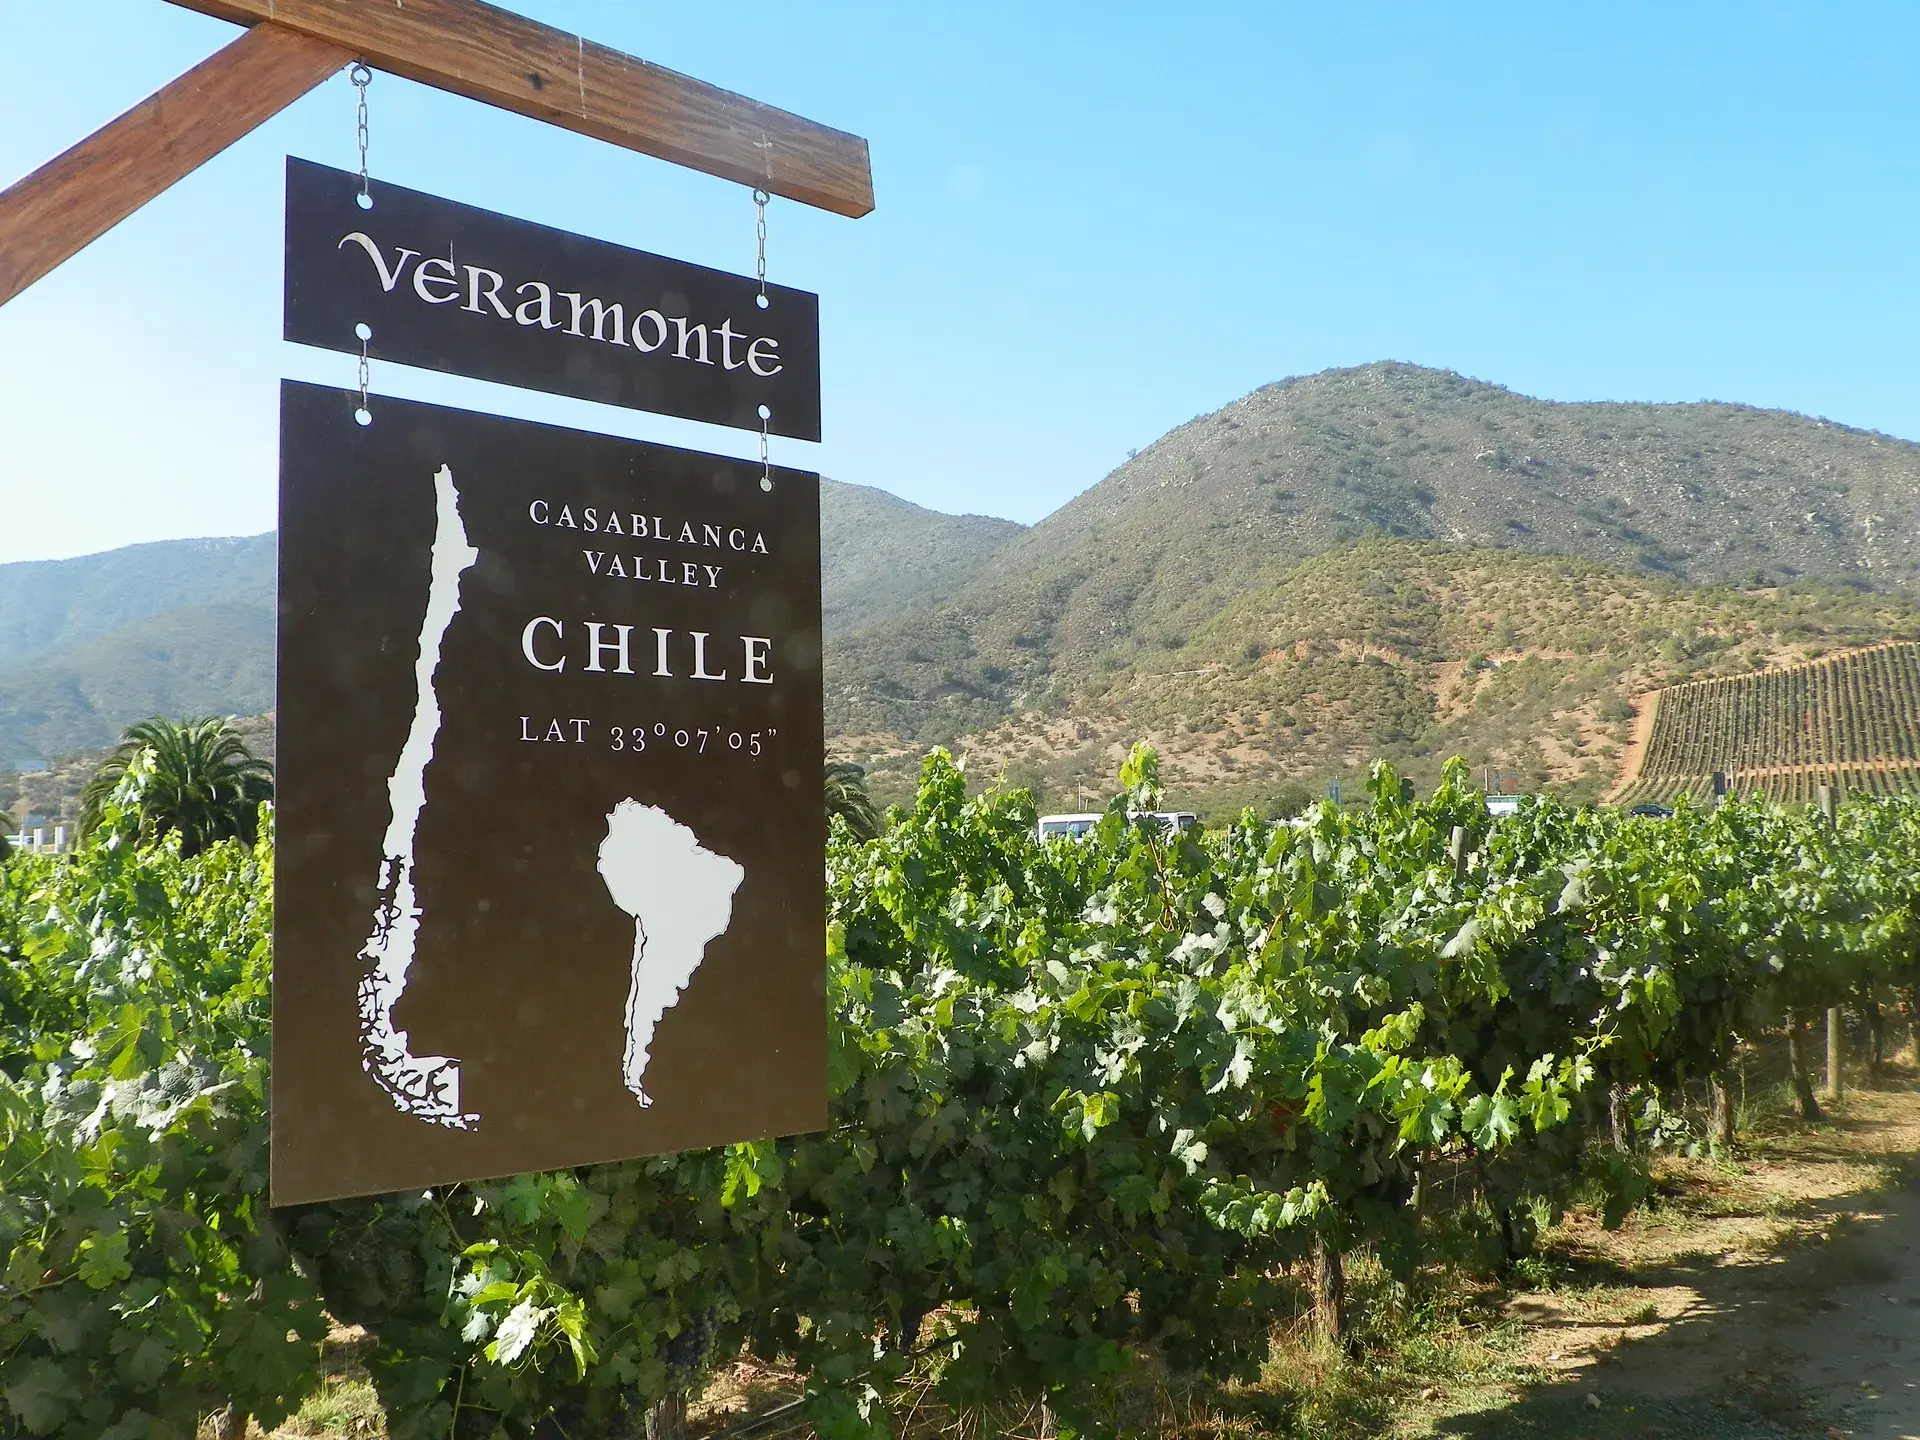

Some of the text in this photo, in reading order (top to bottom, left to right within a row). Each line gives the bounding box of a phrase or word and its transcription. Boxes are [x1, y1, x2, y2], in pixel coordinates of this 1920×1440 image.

[529, 499, 770, 555] CASABLANCA
[582, 549, 723, 589] VALLEY
[521, 616, 775, 685] CHILE
[519, 716, 591, 743] LAT
